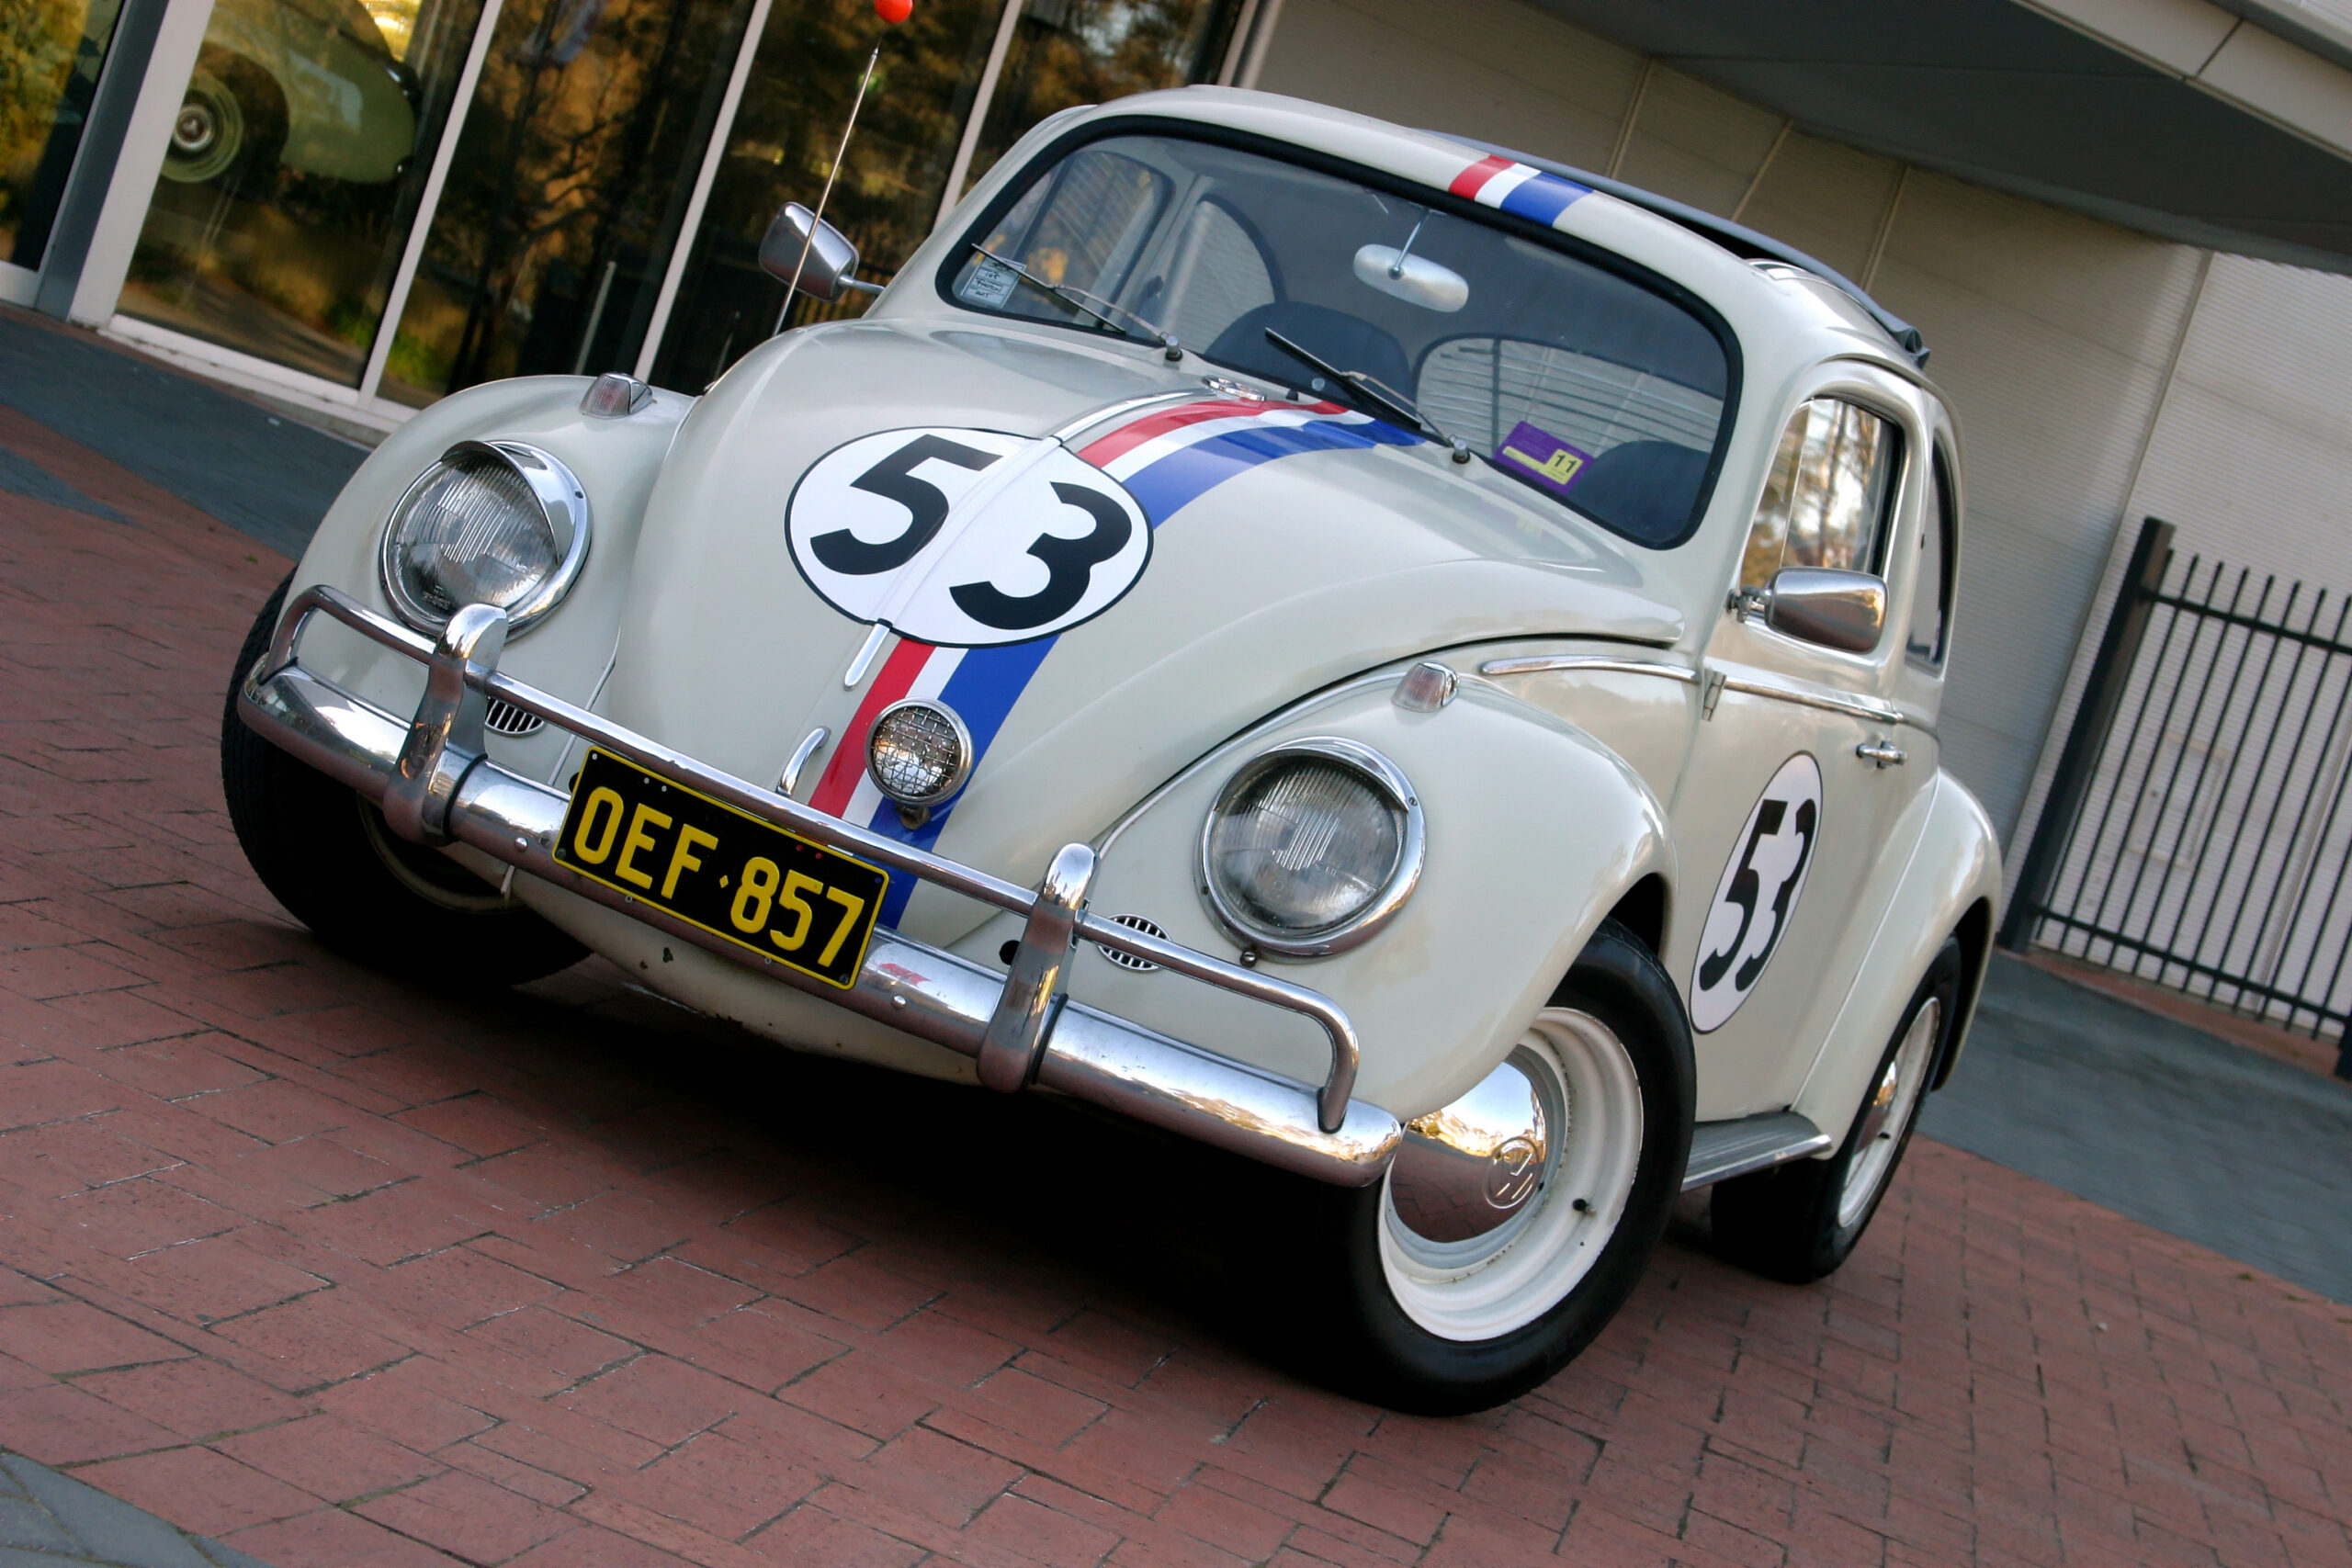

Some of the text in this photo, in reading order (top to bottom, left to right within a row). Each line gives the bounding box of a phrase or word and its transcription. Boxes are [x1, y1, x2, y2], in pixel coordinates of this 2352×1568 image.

[810, 434, 1132, 630] 53
[1555, 454, 1577, 473] 11
[1699, 798, 1816, 992] 53
